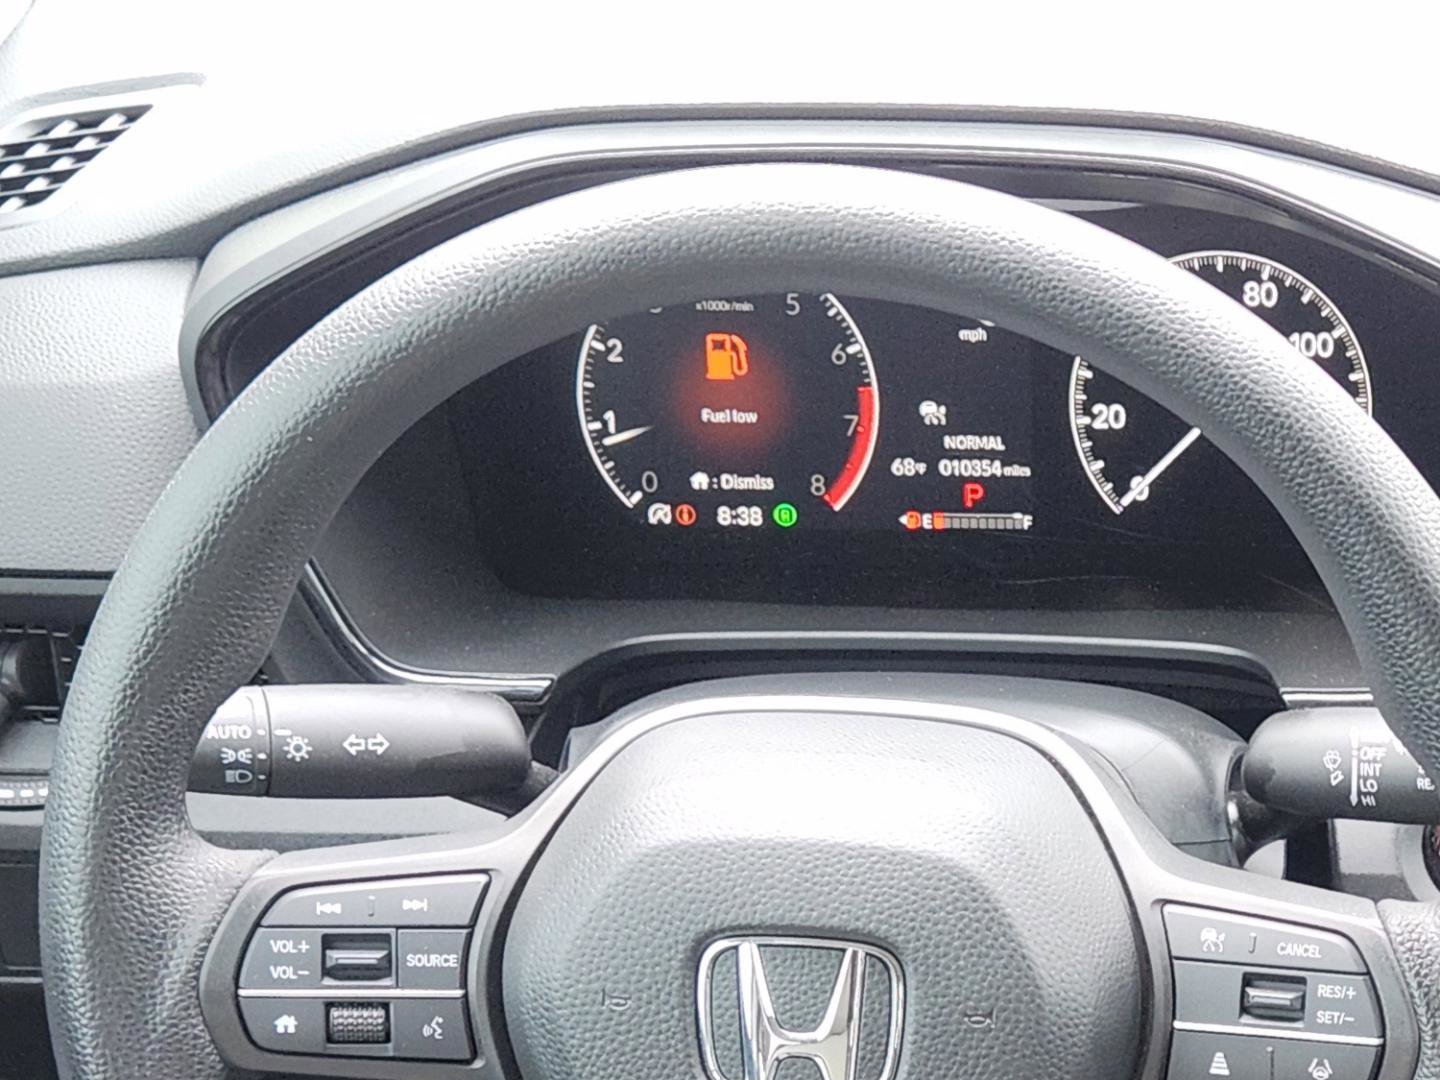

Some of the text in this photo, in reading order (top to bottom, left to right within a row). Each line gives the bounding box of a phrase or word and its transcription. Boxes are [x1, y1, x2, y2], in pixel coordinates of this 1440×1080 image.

[1243, 280, 1278, 308] 80
[785, 293, 800, 316] 5
[959, 327, 988, 345] mph
[606, 337, 624, 363] 2
[1289, 332, 1335, 359] 100
[831, 344, 847, 366] 6
[602, 410, 616, 434] 1
[701, 408, 758, 424] Fuel low
[1091, 403, 1127, 430] 20
[843, 415, 859, 437] 7
[943, 435, 1006, 451] NORMAL
[938, 458, 1002, 478] 010354
[641, 471, 658, 492] 0
[720, 474, 775, 491] Dismiss
[810, 474, 827, 497] 8
[962, 481, 985, 508] P
[716, 506, 763, 526] 8:38
[922, 513, 932, 530] E
[1023, 515, 1033, 530] F
[206, 725, 252, 741] AUTO
[1360, 746, 1388, 761] OFF
[1360, 762, 1382, 777] INT
[1360, 778, 1378, 793] LO
[1361, 794, 1376, 807] HI
[1276, 942, 1322, 958] CANCEL
[406, 954, 458, 967] SOURCE
[1317, 984, 1357, 1000] RES/+
